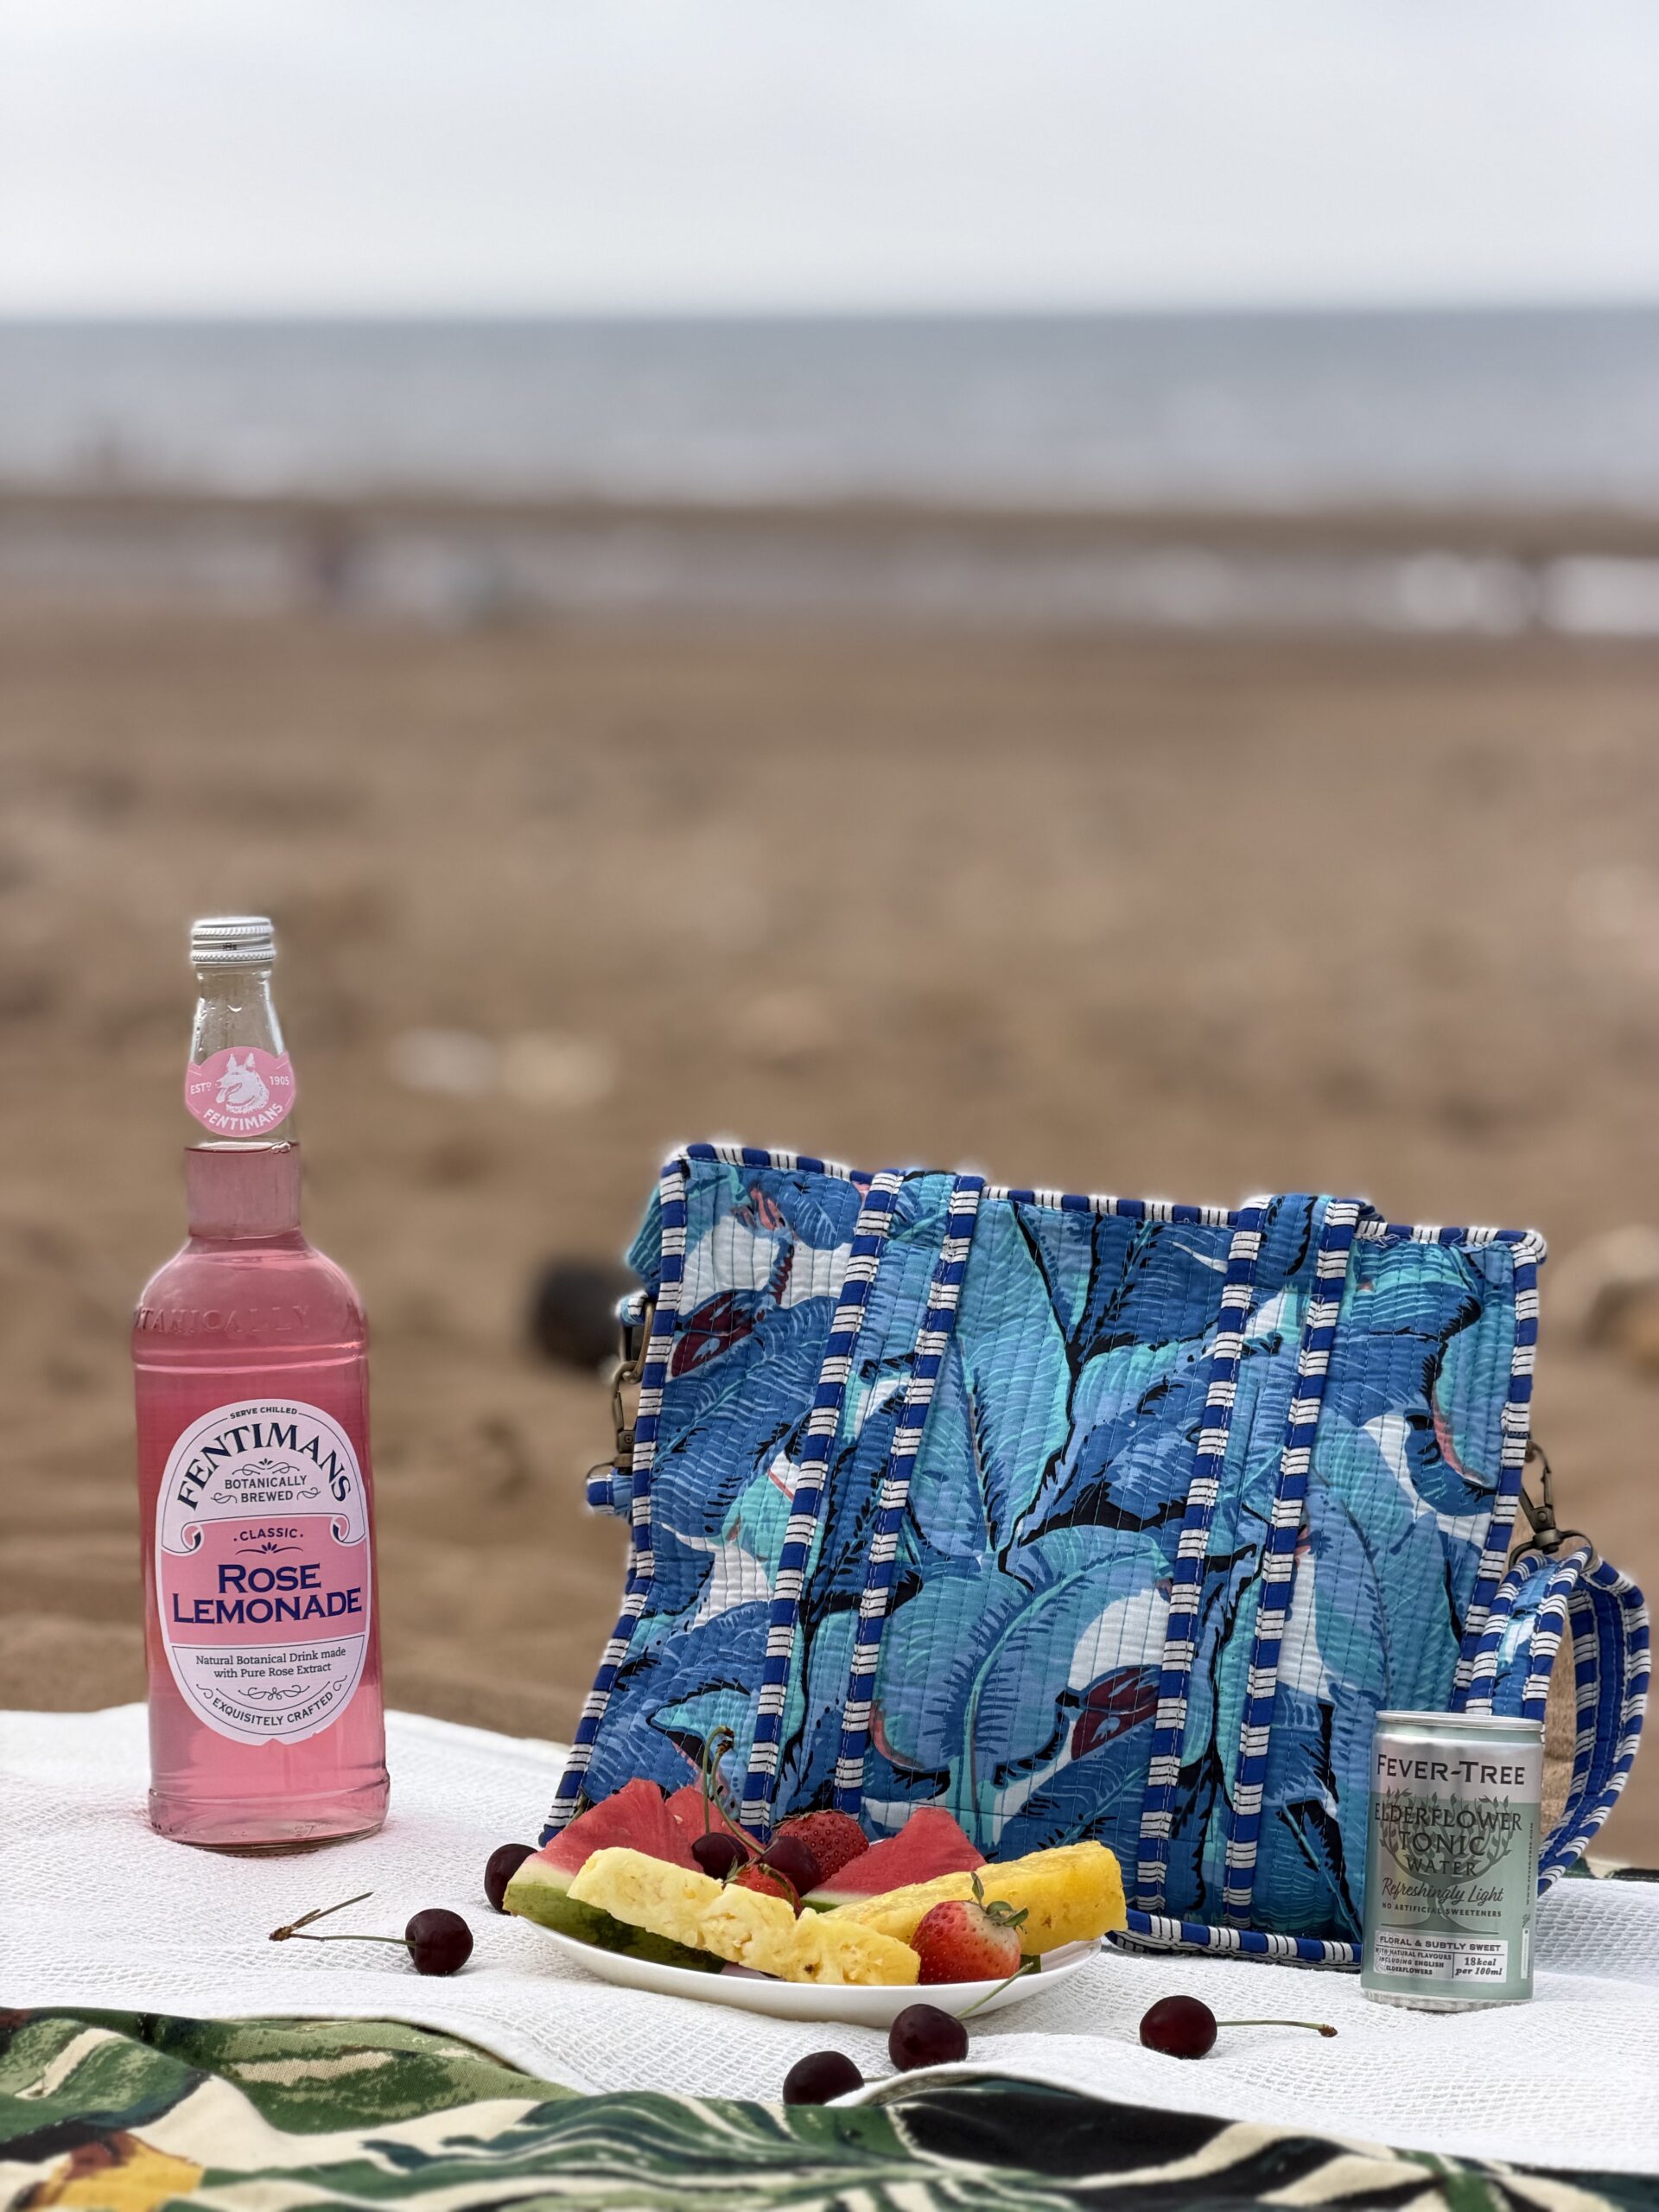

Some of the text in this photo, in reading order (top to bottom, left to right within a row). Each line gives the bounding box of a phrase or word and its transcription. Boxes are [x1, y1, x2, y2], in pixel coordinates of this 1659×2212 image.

[270, 1076, 290, 1086] 1905
[203, 1103, 283, 1131] FENTIMANS
[230, 1406, 297, 1420] SERVE CHILLED
[176, 1422, 351, 1511] FENTIMANS
[225, 1475, 307, 1490] BOTANICALLY
[241, 1491, 293, 1503] BREWED
[239, 1528, 298, 1541] CLASSIC
[218, 1562, 321, 1594] ROSE
[172, 1587, 362, 1624] LEMONADE
[195, 1646, 346, 1666] Natural Botanical Drink made
[213, 1662, 332, 1679] with Pure Rose Extract
[213, 1691, 334, 1726] EXQUISITELY CRAFTED
[1376, 1754, 1526, 1785] FEVER-TREE
[1375, 1802, 1523, 1832] ELDERFLOWER
[1399, 1830, 1486, 1857] TONIC
[1407, 1857, 1478, 1877] WATER
[1382, 1877, 1503, 1906] Refreshingly Light
[1395, 1904, 1442, 1915] ARTIFICIAL
[1445, 1908, 1502, 1917] SWEETENERS
[1380, 1936, 1412, 1947] FLORAL
[1426, 1941, 1466, 1950] SUBTLY
[1379, 1956, 1445, 1968] INCLUDING ENGLISH
[1390, 1949, 1416, 1958] NATURAL
[1417, 1952, 1452, 1961] FLAVOURS
[1465, 1957, 1497, 1967] 18kcal
[1386, 1965, 1433, 1975] ELDERFLOWERS
[1475, 1967, 1503, 1976] 100ml
